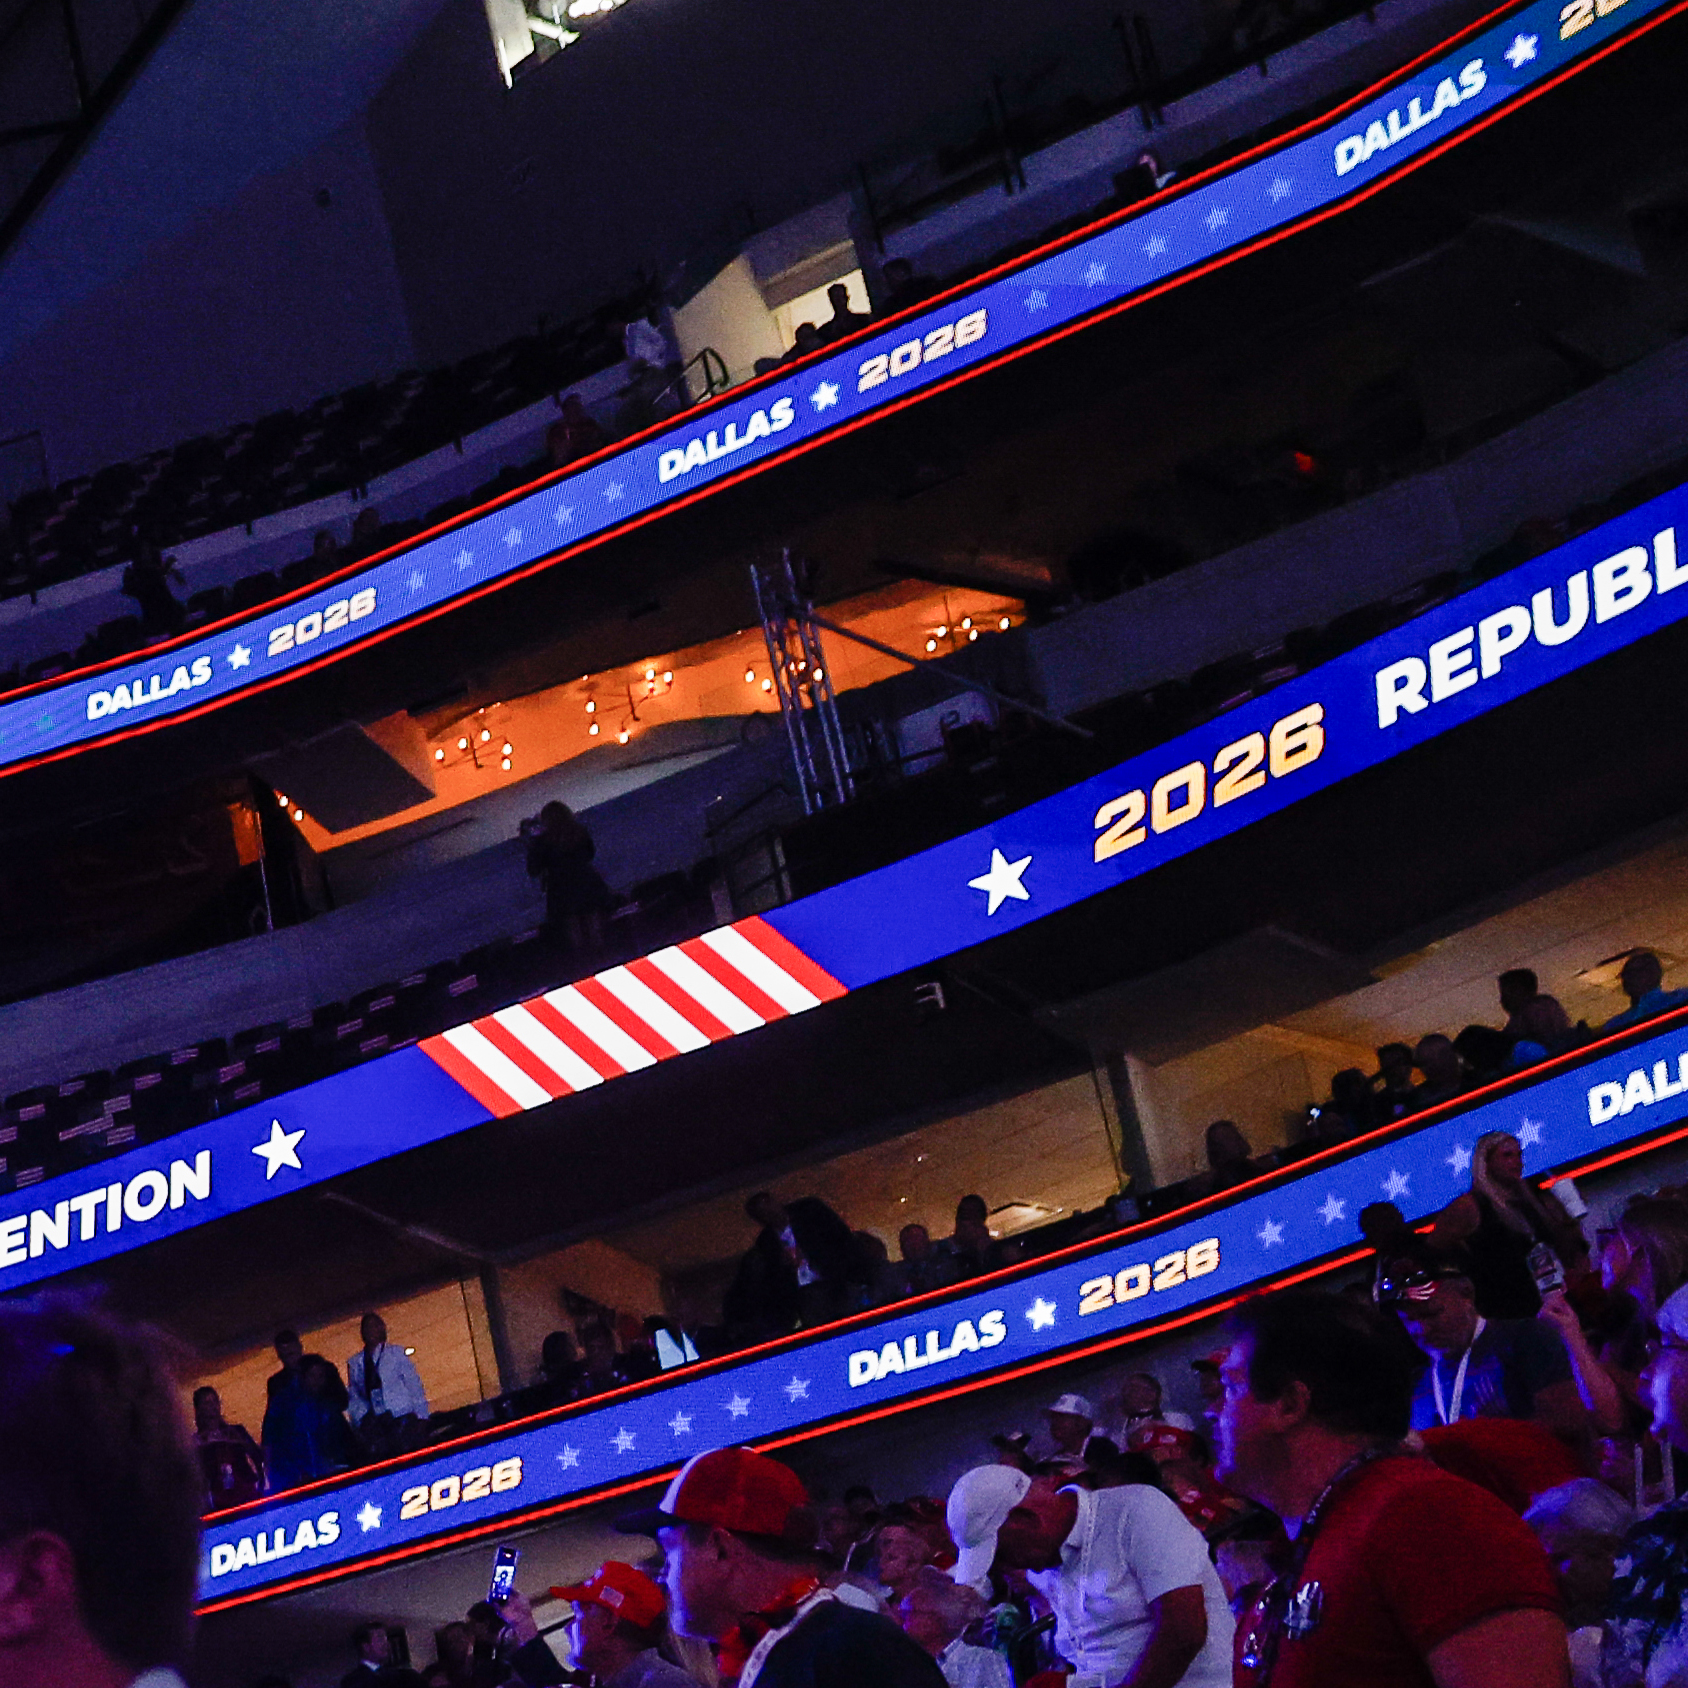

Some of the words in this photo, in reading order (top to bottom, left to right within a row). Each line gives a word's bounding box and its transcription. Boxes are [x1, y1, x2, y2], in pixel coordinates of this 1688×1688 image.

[1335, 59, 1487, 176] DALLAS
[659, 399, 794, 482] DALLAS
[857, 307, 988, 394] 2026
[86, 655, 212, 721] DALLAS
[267, 587, 377, 657] 2026
[1093, 702, 1324, 863] 2026
[848, 1309, 1008, 1388] DALLAS
[1078, 1237, 1221, 1317] 2026
[210, 1511, 341, 1578] DALLAS
[399, 1455, 523, 1521] 2026
